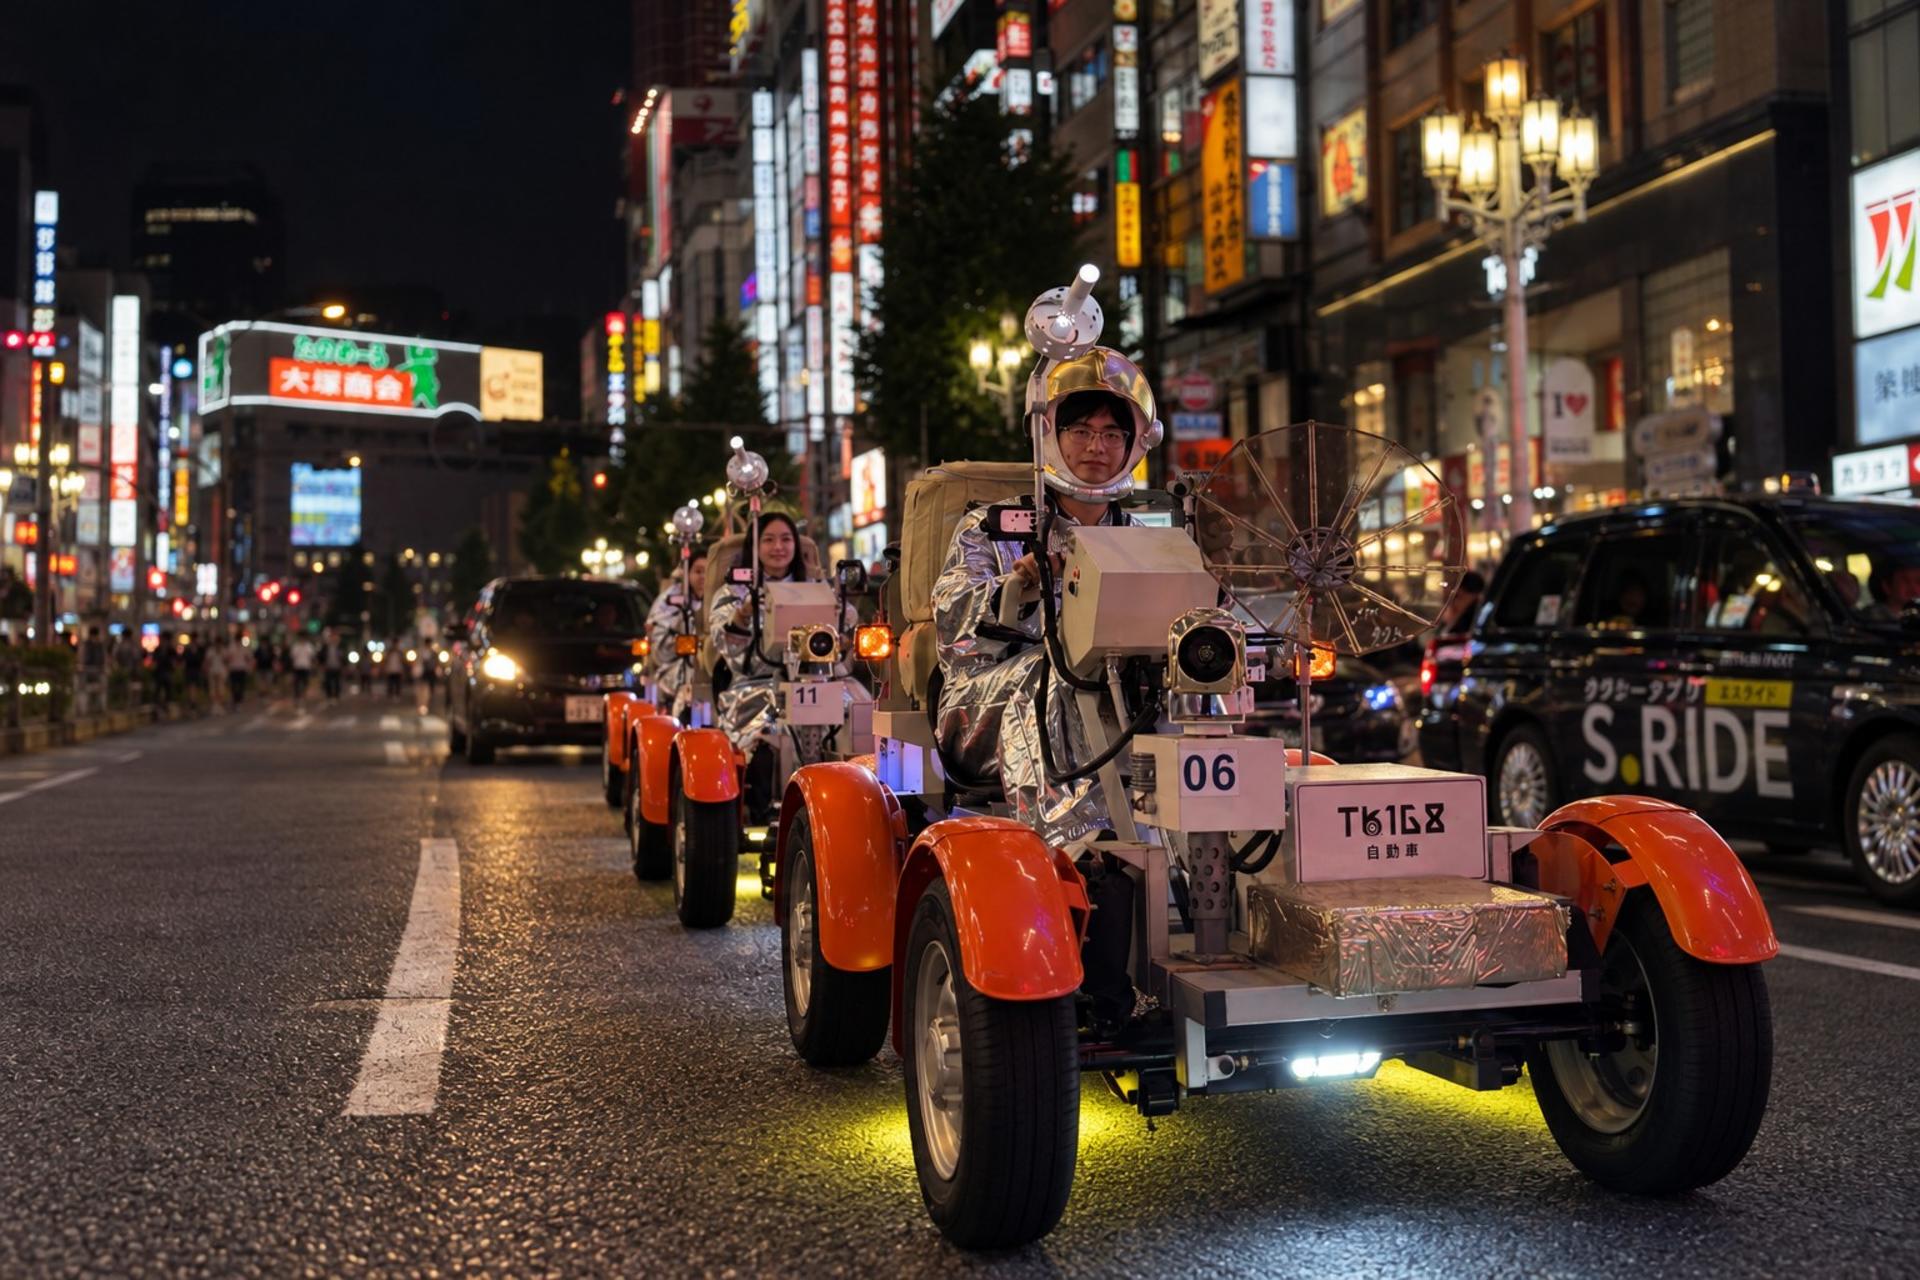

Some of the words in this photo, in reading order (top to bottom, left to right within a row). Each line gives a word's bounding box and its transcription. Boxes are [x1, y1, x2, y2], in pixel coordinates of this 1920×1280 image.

[280, 366, 403, 401] 大塚商会
[796, 686, 816, 704] 11
[1582, 702, 1794, 798] S.RIDE
[1183, 753, 1236, 792] 06
[1366, 842, 1419, 861] 自動車
